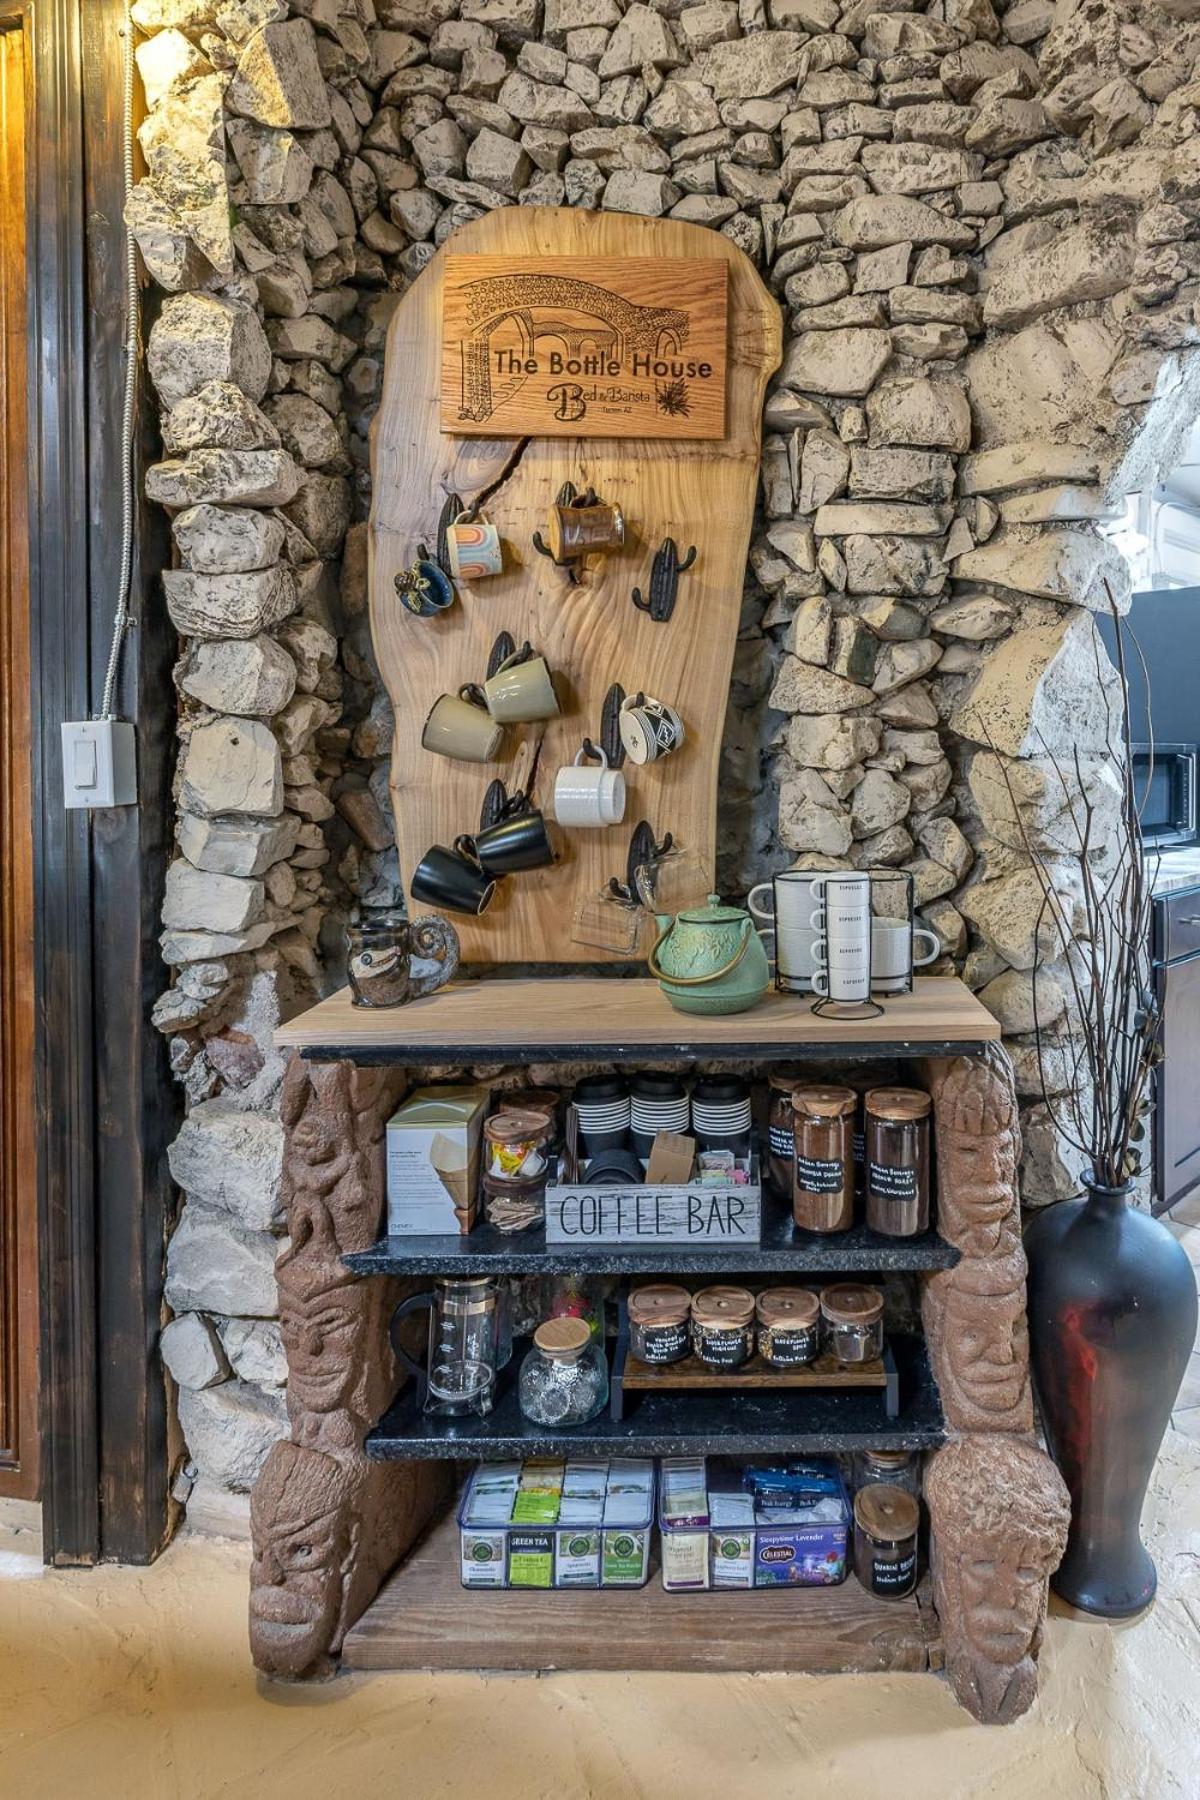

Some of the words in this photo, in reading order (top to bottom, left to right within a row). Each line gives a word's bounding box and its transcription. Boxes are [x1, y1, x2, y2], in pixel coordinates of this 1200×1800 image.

[494, 350, 538, 375] The
[550, 351, 620, 377] Bottle
[632, 353, 712, 378] House
[547, 383, 597, 421] Bed
[607, 387, 650, 402] Barista
[560, 1195, 673, 1235] COFFEE
[687, 1195, 746, 1235] BAR
[511, 1538, 533, 1546] GREEN
[534, 1537, 548, 1546] TEA
[760, 1534, 794, 1544] Sleepytime
[796, 1533, 823, 1542] Lavender
